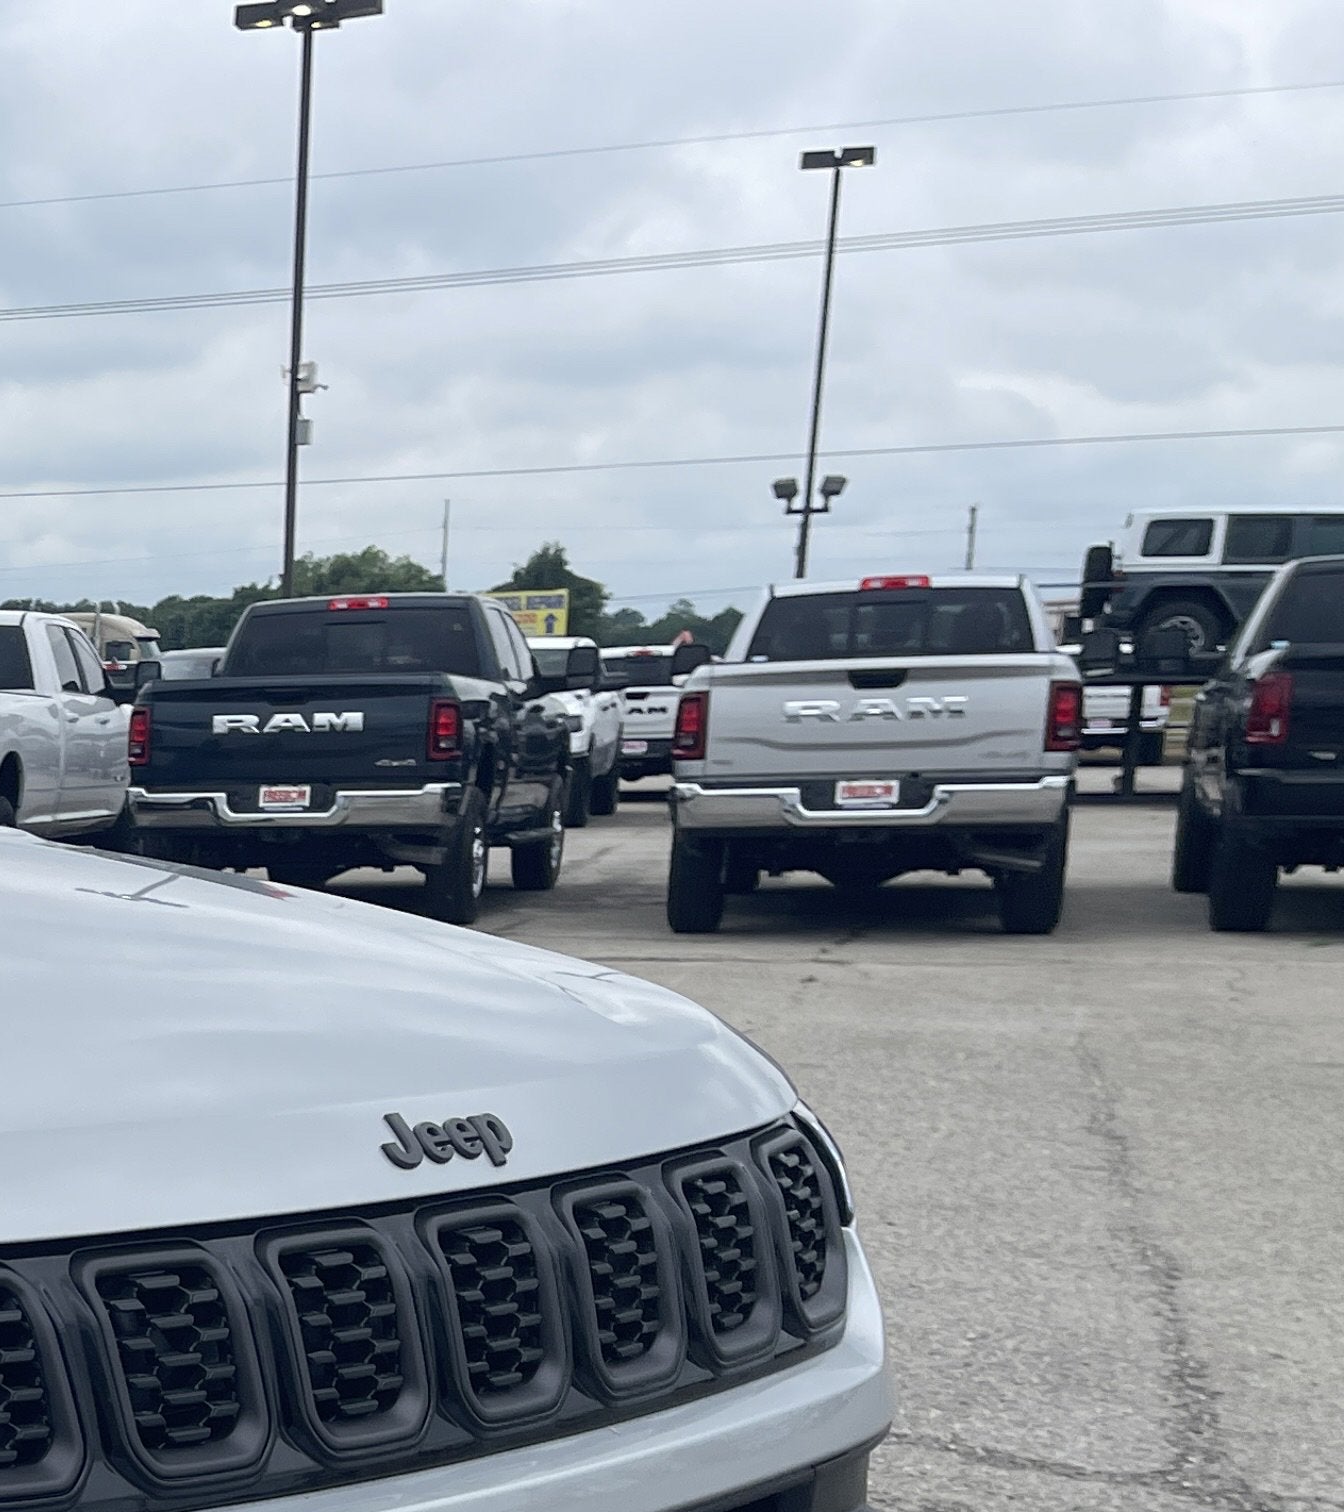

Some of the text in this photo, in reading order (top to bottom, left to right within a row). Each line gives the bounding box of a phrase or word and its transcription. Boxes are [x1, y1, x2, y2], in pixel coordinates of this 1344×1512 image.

[212, 711, 364, 735] RAM
[783, 696, 969, 723] RAM
[380, 1112, 513, 1170] Jeep
